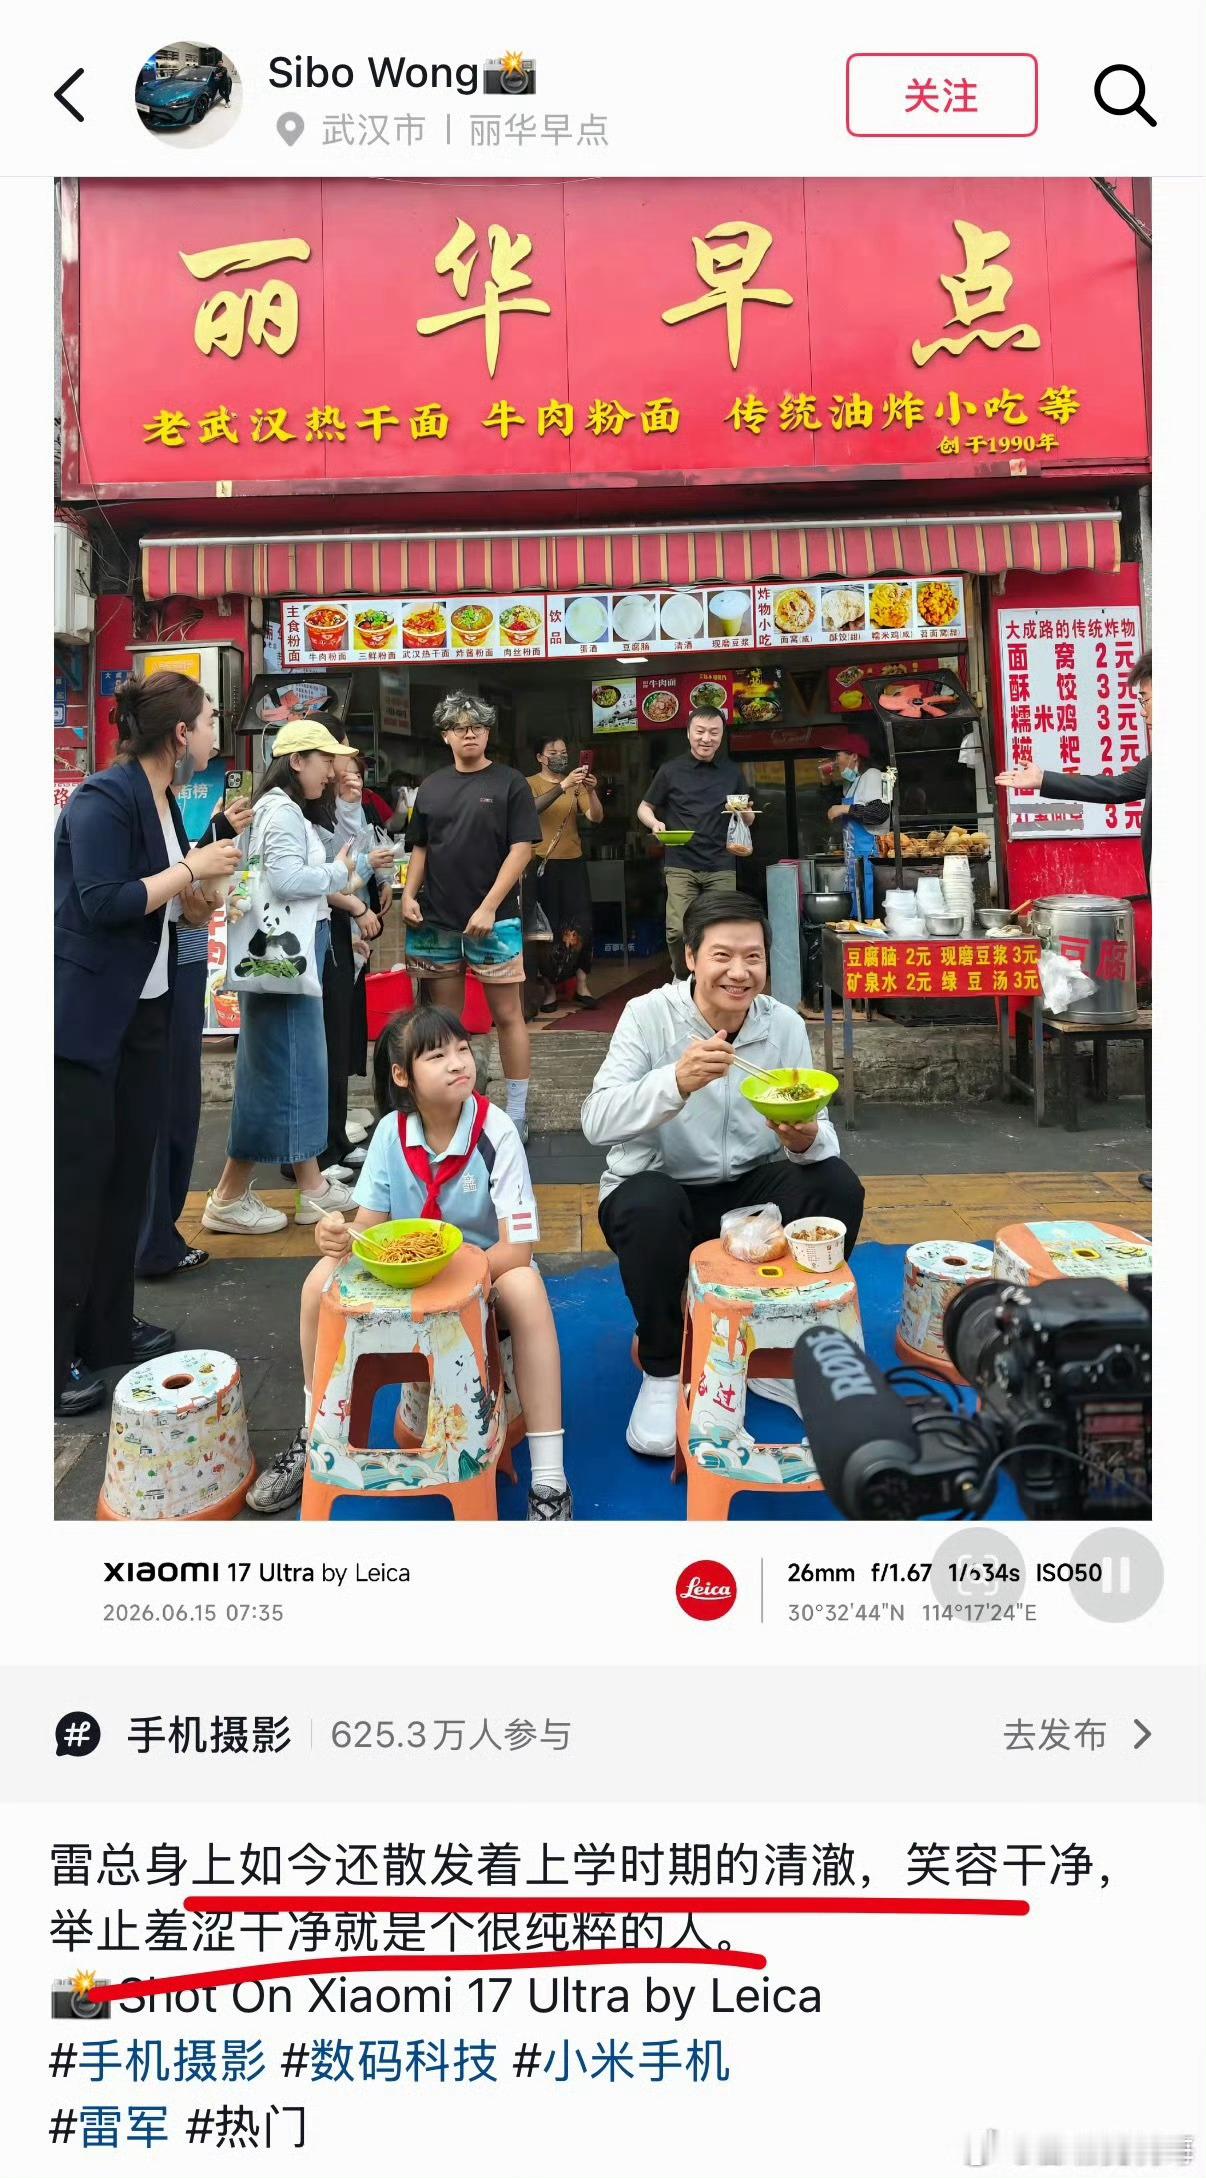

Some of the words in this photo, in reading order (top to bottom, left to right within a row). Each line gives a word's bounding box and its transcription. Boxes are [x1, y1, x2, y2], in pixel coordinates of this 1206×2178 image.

[178, 216, 1042, 379] 丽华早点
[142, 403, 450, 447] 老武汉热干面
[481, 396, 681, 440] 牛肉粉面
[723, 385, 1082, 436] 传统油炸小吃等
[936, 433, 1060, 455] 创于1990年
[549, 609, 562, 645] 饮品
[757, 587, 772, 647] 炸物小吃
[1005, 618, 1136, 640] 大成路的传统炸物
[286, 605, 301, 663] 主食粉面
[1010, 703, 1077, 734] 糯米鸡
[846, 945, 897, 968] 豆腐脑
[905, 946, 932, 968] 2元
[940, 945, 1008, 967] 现磨豆浆
[1012, 944, 1039, 966] 3元
[846, 970, 898, 993] 矿泉水
[906, 971, 932, 992] 2元
[941, 970, 1009, 992] 绿豆汤
[1013, 969, 1039, 990] 3元
